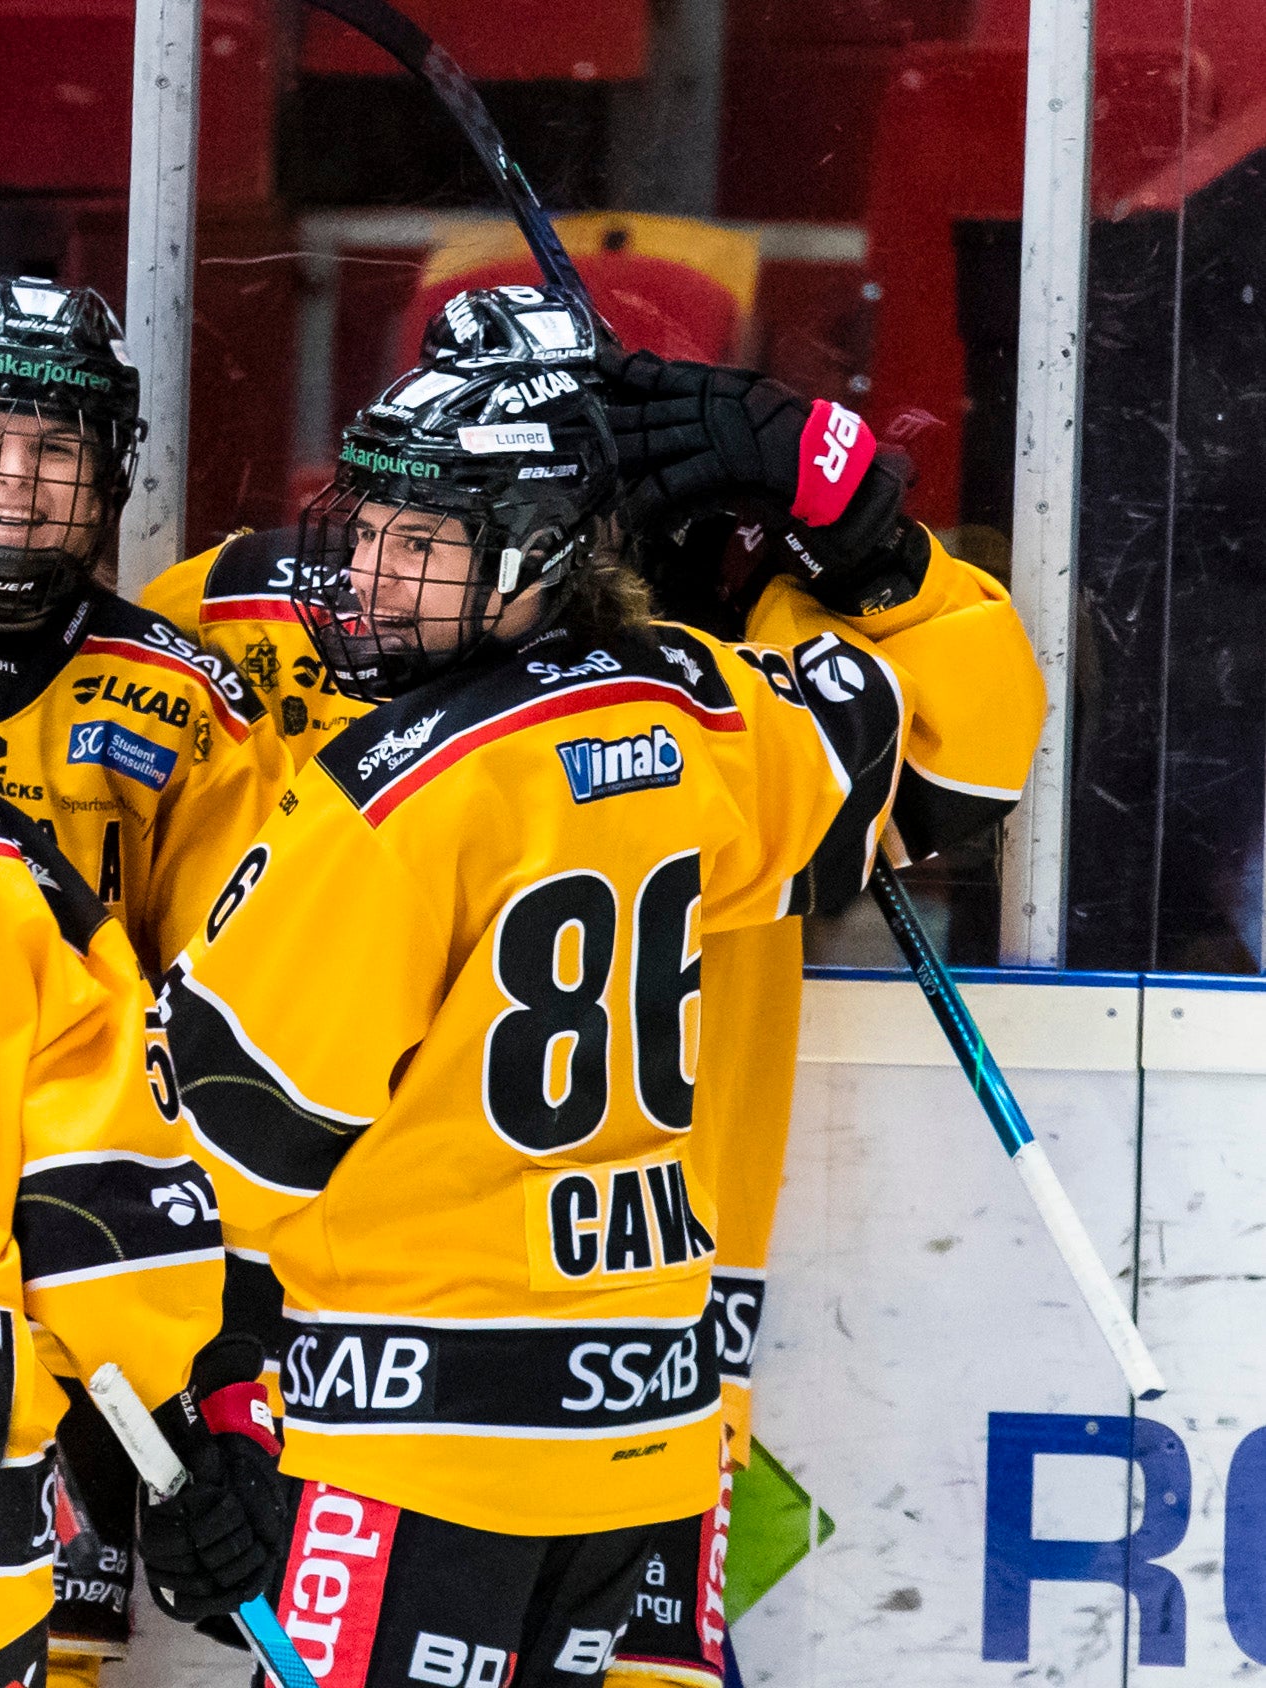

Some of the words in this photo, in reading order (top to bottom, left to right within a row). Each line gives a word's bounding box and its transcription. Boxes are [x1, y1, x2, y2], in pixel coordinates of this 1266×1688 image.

[516, 370, 580, 408] LKAB
[340, 443, 440, 479] äkarjouren
[143, 622, 245, 701] SSAB
[102, 675, 191, 728] LKAB
[106, 744, 167, 784] Consulting
[111, 734, 157, 762] Student
[559, 727, 683, 801] Vinab
[482, 846, 701, 1156] 86
[283, 1335, 430, 1410] SSAB
[561, 1327, 699, 1412] SSAB
[611, 1441, 668, 1462] BAUER
